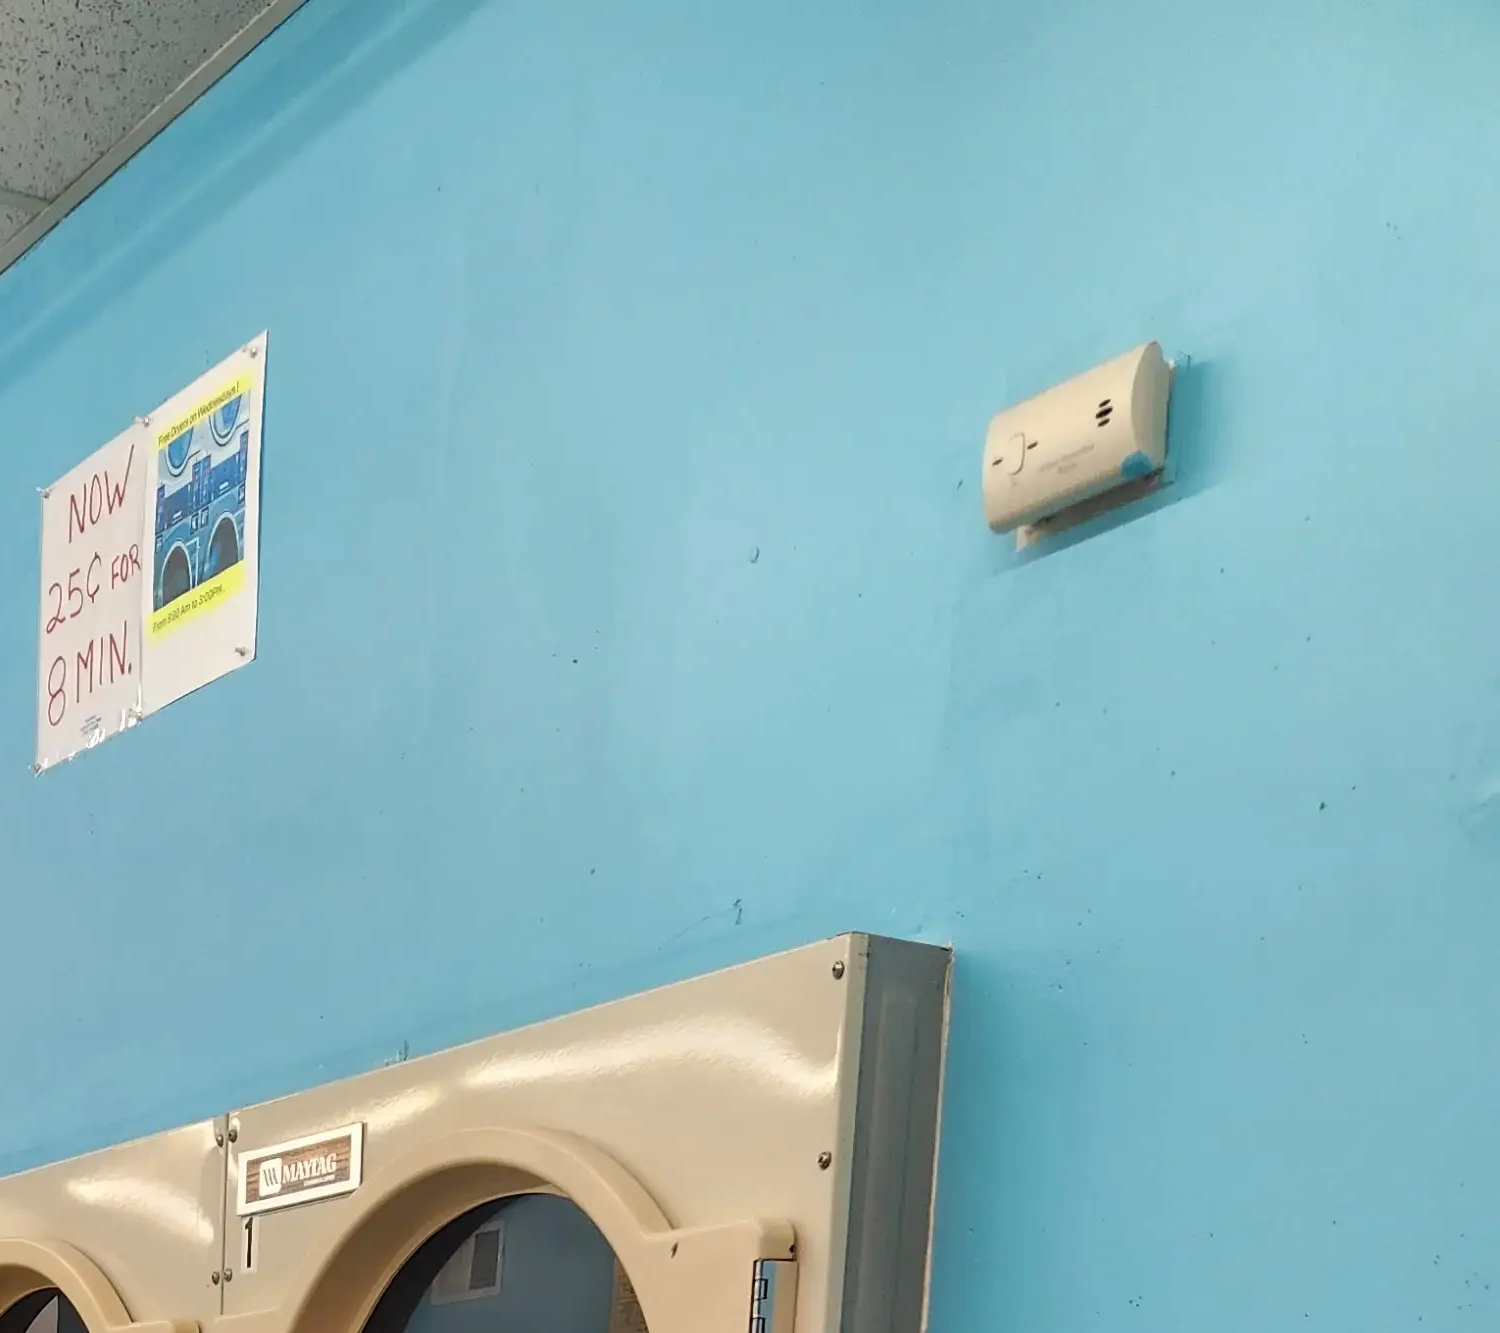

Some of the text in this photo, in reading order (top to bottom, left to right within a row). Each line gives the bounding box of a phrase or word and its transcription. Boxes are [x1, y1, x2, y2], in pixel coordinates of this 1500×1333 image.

[68, 444, 135, 543] NOW
[46, 543, 141, 634] 25¢ FOR
[47, 620, 133, 727] 8 MIN.
[282, 1152, 338, 1184] MAYTAG
[245, 1217, 253, 1268] 1
